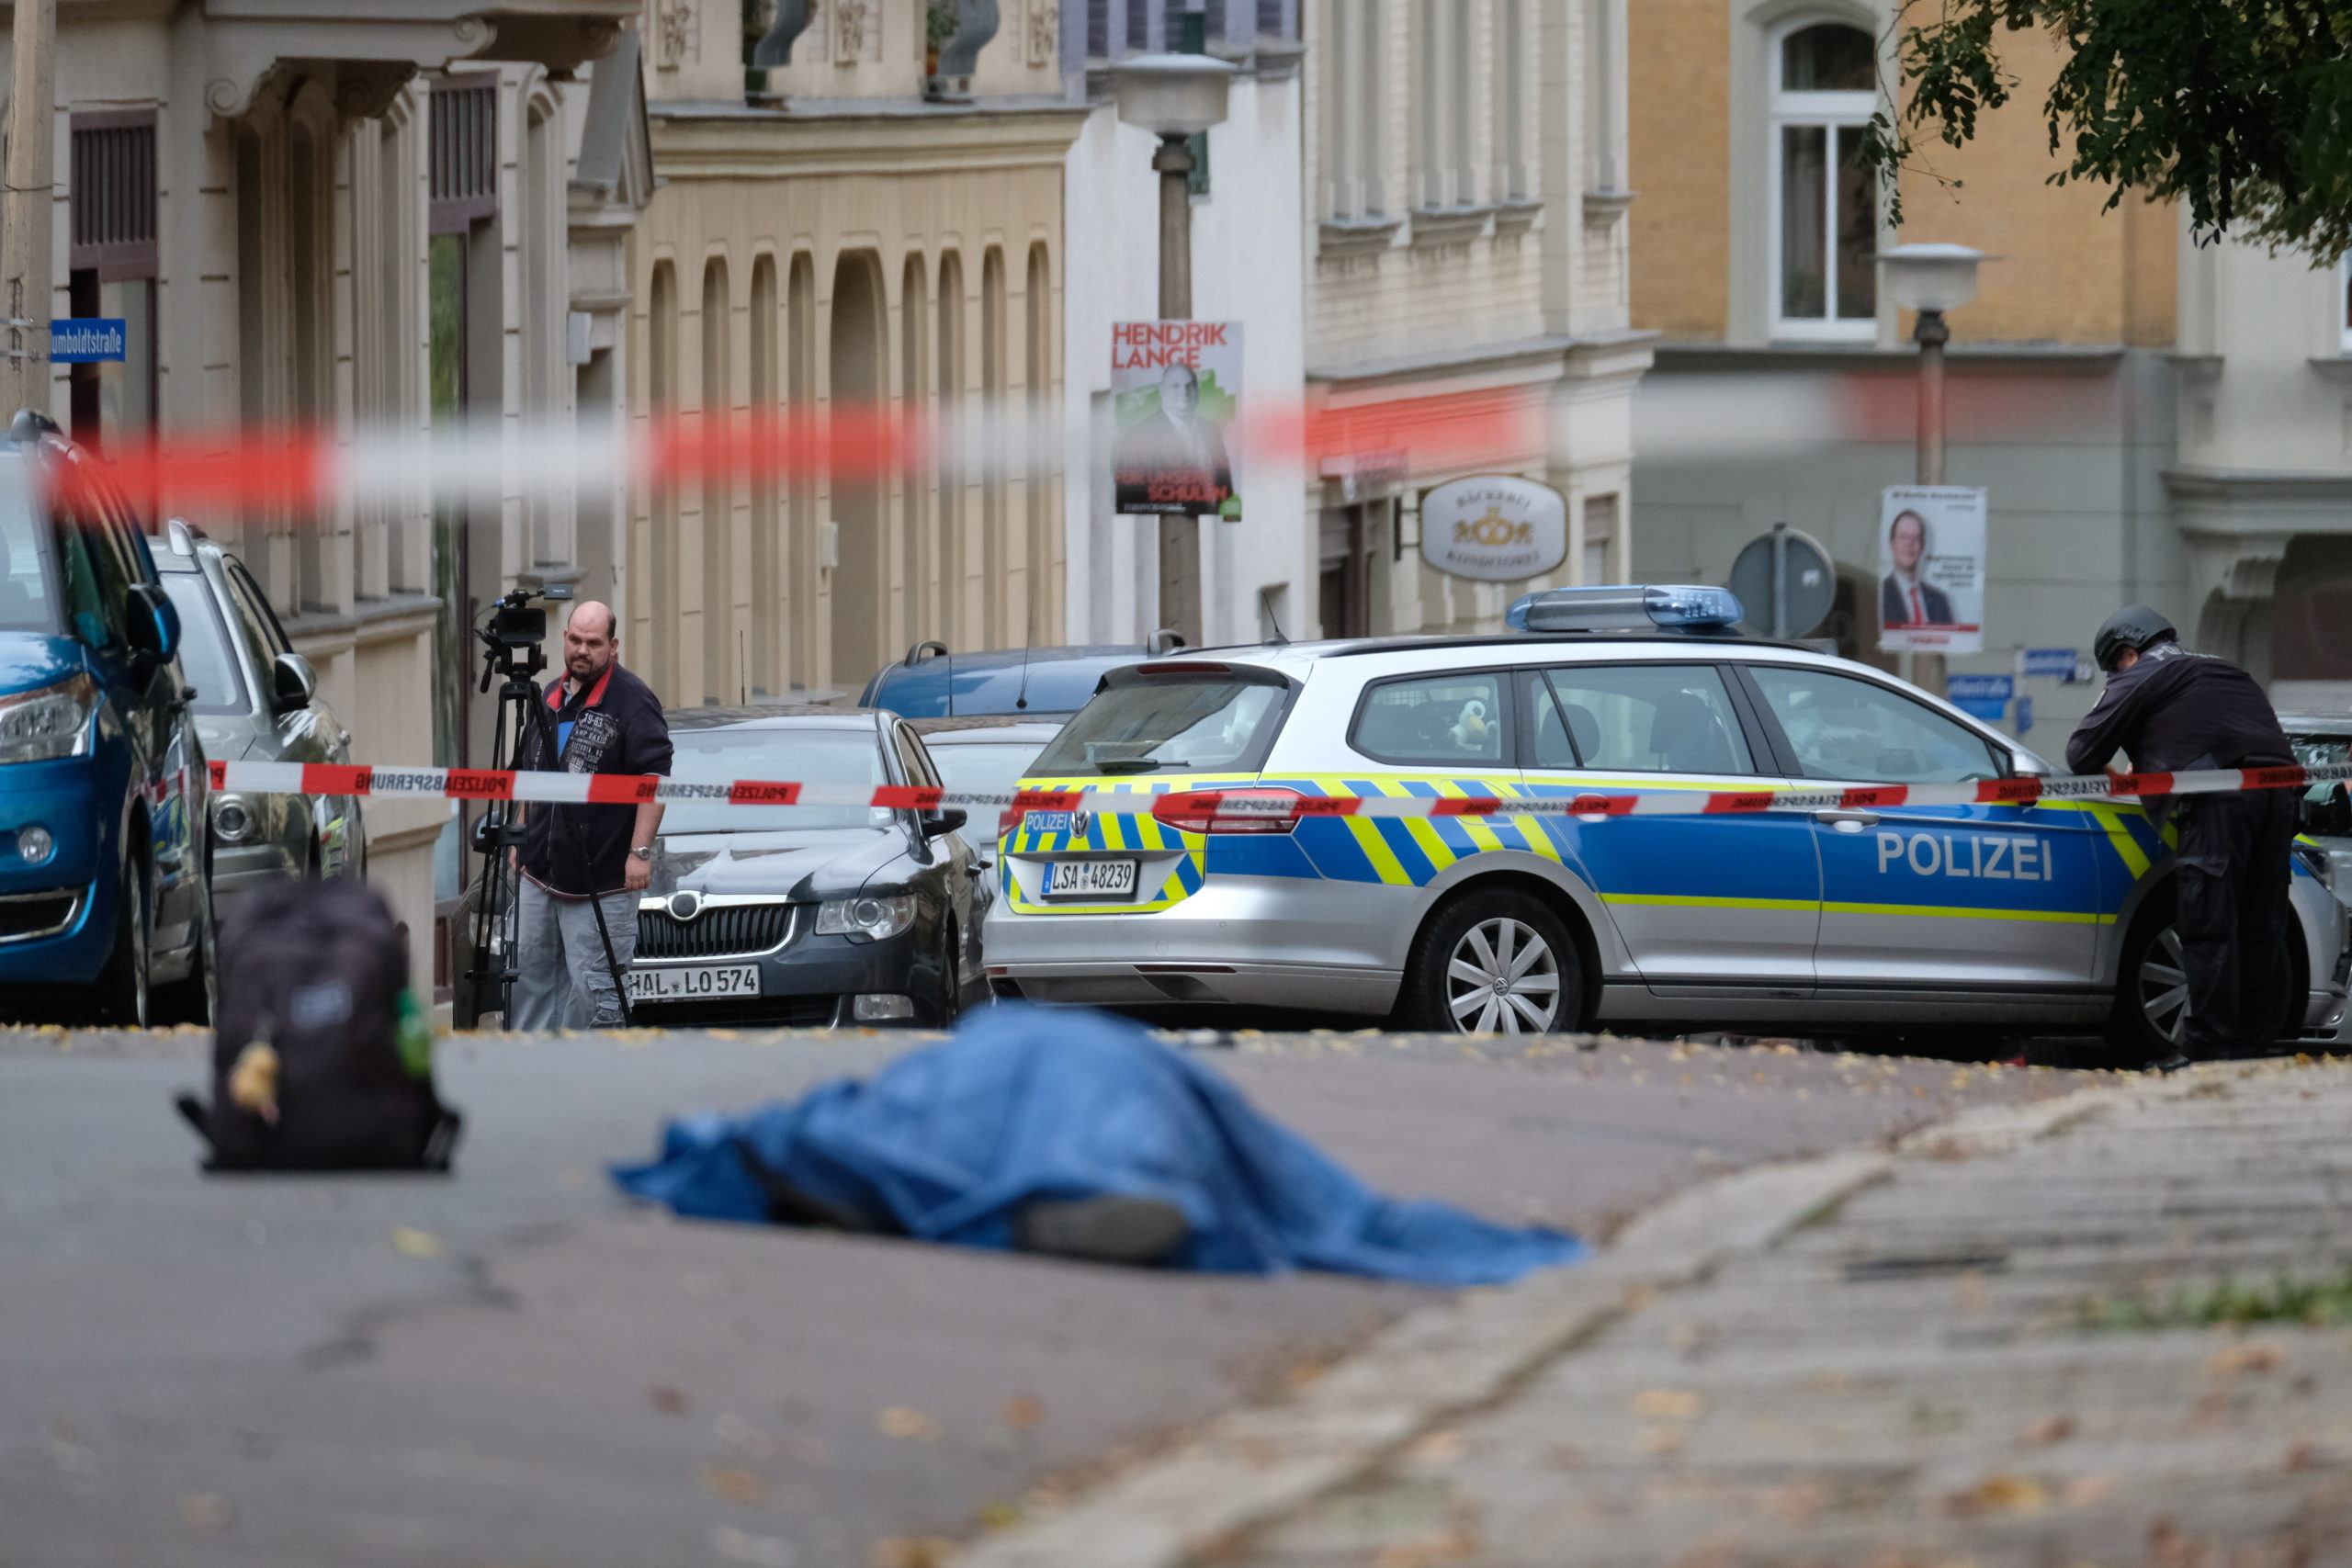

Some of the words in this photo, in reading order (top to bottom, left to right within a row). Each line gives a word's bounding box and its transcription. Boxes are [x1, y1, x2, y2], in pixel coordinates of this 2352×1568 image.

[51, 326, 122, 355] umboldtstraße
[1112, 322, 1227, 345] HENDRIK
[1112, 346, 1201, 369] LANGE
[1026, 814, 1068, 831] POLIZEI
[1877, 832, 2052, 881] POLIZEI
[1052, 864, 1078, 889] LSA
[1091, 863, 1132, 889] 48239
